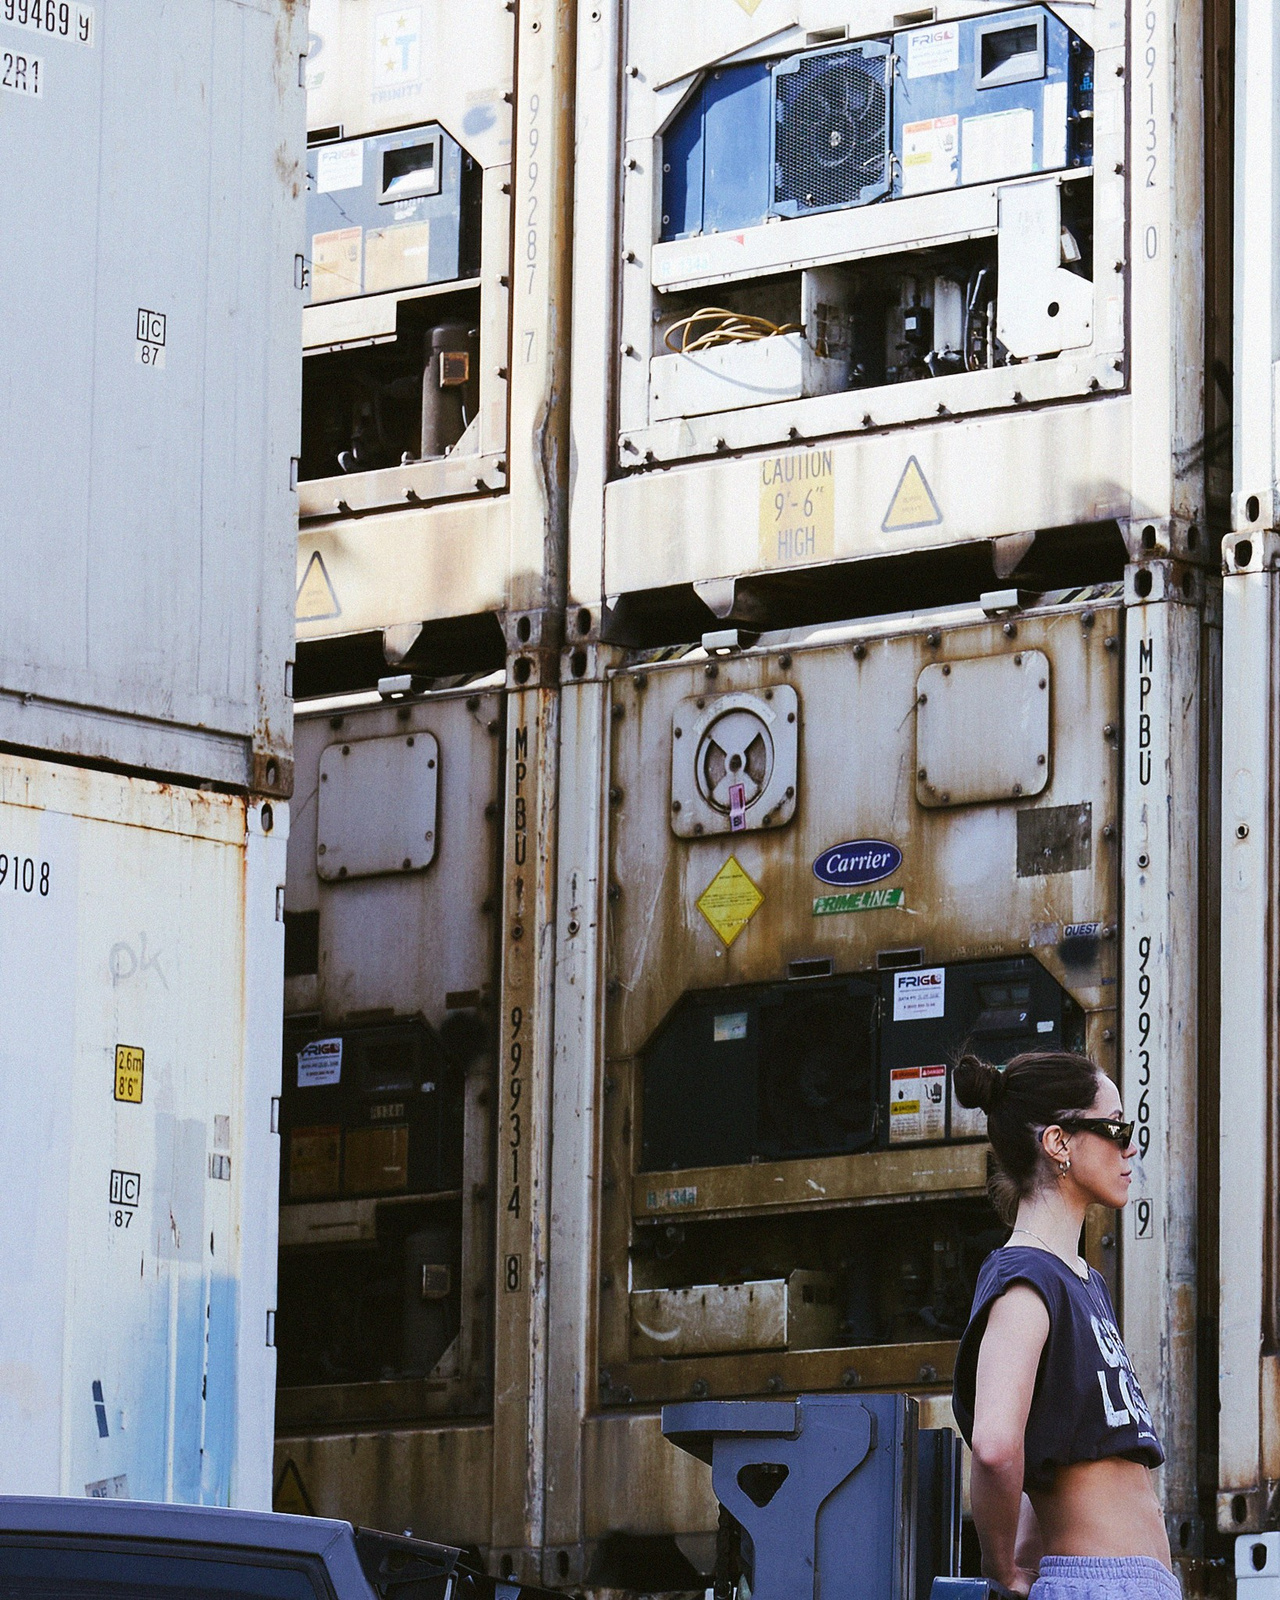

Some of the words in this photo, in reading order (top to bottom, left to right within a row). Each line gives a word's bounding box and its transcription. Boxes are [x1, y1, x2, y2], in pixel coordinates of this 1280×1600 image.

[5, 0, 69, 36] 99469
[3, 53, 39, 94] 2R1
[1145, 0, 1157, 188] 99132
[524, 94, 540, 295] 9992877
[141, 345, 159, 365] 87
[524, 331, 535, 363] 7
[762, 450, 832, 486] CAUTION
[778, 525, 816, 561] HIGH
[1139, 638, 1153, 786] MPBU
[515, 726, 528, 867] MPBU
[826, 851, 891, 875] Carrier
[1065, 924, 1098, 937] QUEST
[898, 974, 942, 989] FRIGO
[1137, 936, 1151, 1160] 999369
[508, 1007, 523, 1219] 999314
[114, 1210, 133, 1228] 87
[1137, 1201, 1149, 1236] 9
[507, 1256, 520, 1291] 8
